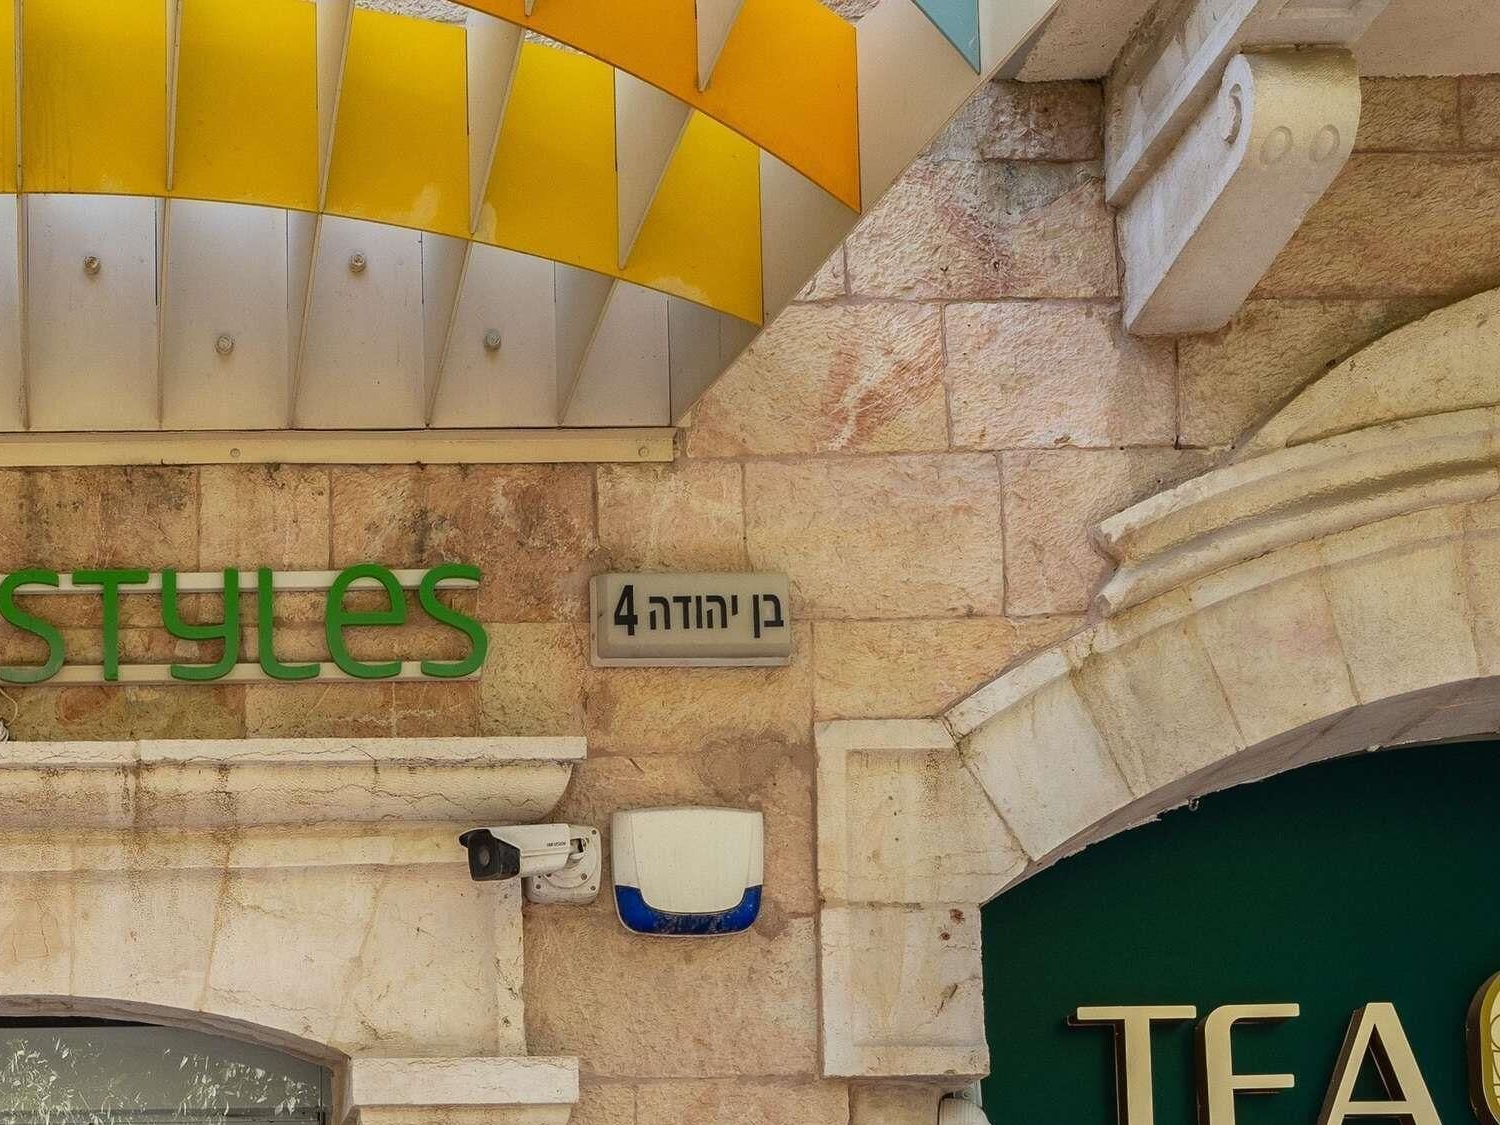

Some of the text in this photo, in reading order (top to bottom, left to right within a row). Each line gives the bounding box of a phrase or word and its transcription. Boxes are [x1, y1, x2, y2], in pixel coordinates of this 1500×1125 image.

[613, 584, 784, 639] בן יהודה 4
